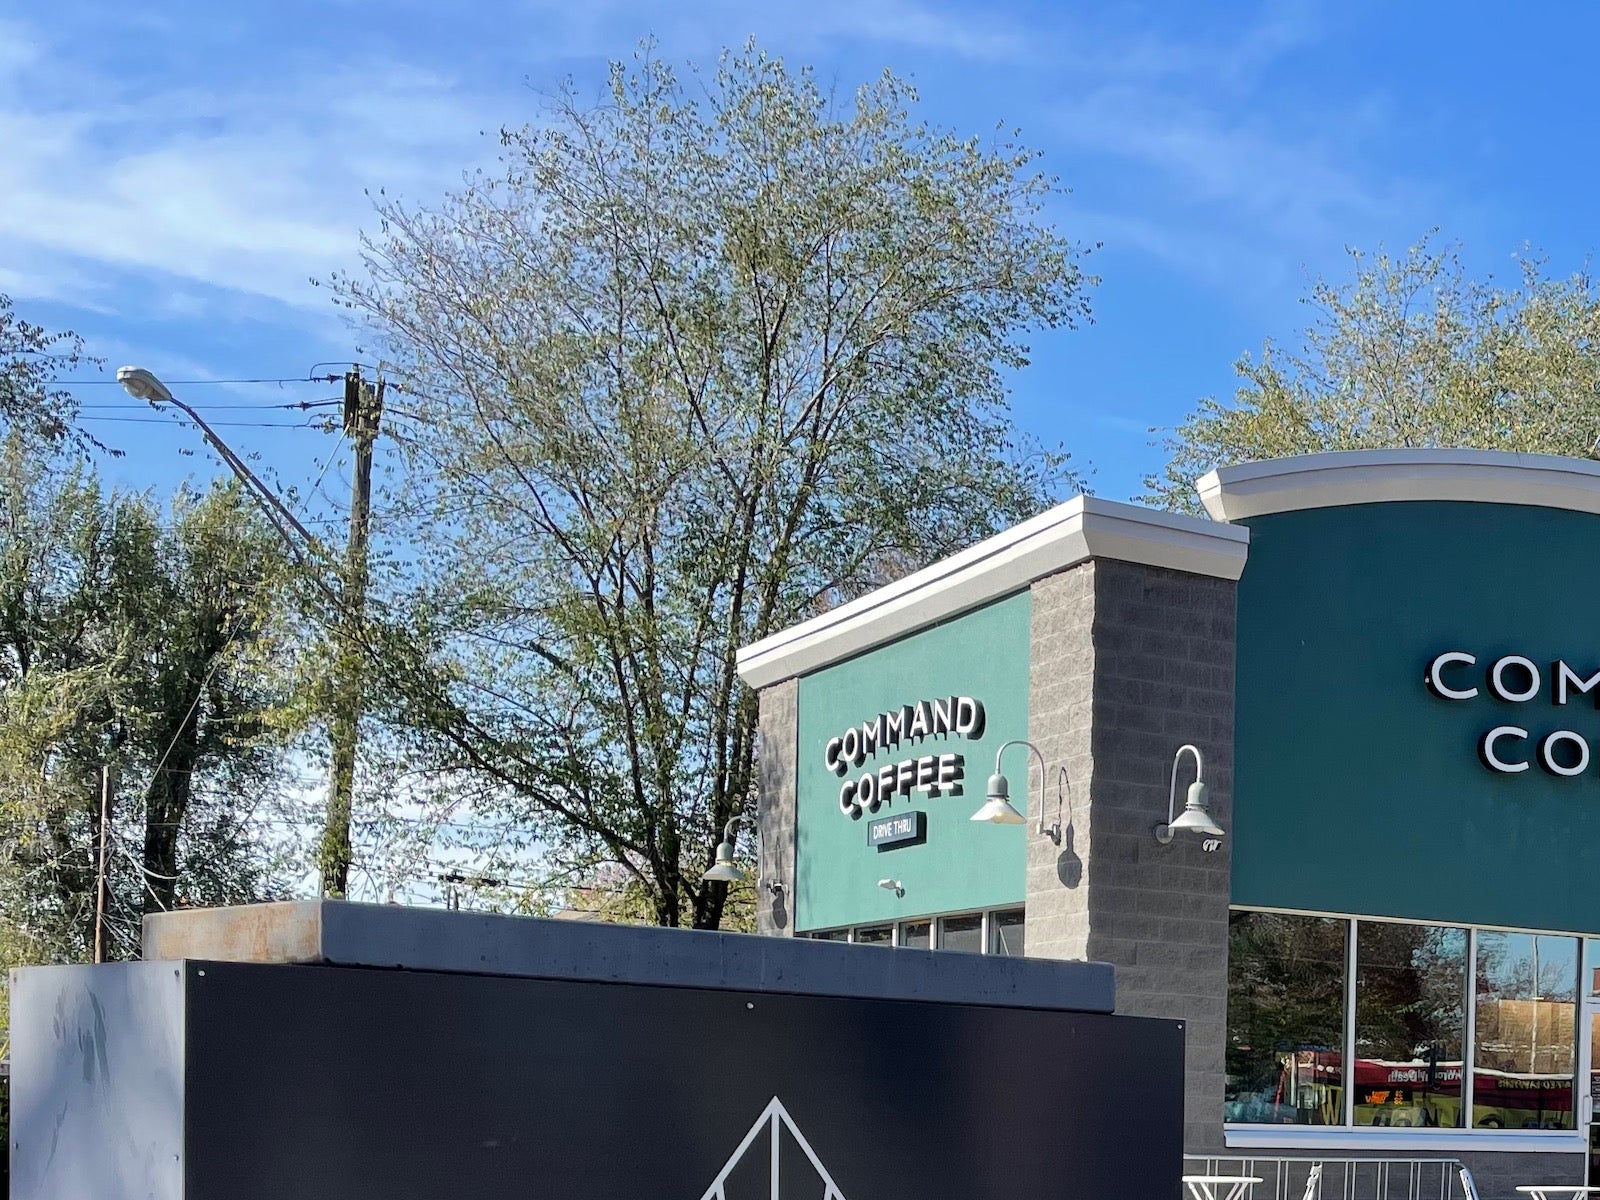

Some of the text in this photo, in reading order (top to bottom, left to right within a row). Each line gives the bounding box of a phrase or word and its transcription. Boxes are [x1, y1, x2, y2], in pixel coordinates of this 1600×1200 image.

[825, 696, 980, 772] COMMAND
[840, 753, 959, 815] COFFEE
[873, 817, 912, 840] DRIVE THRU
